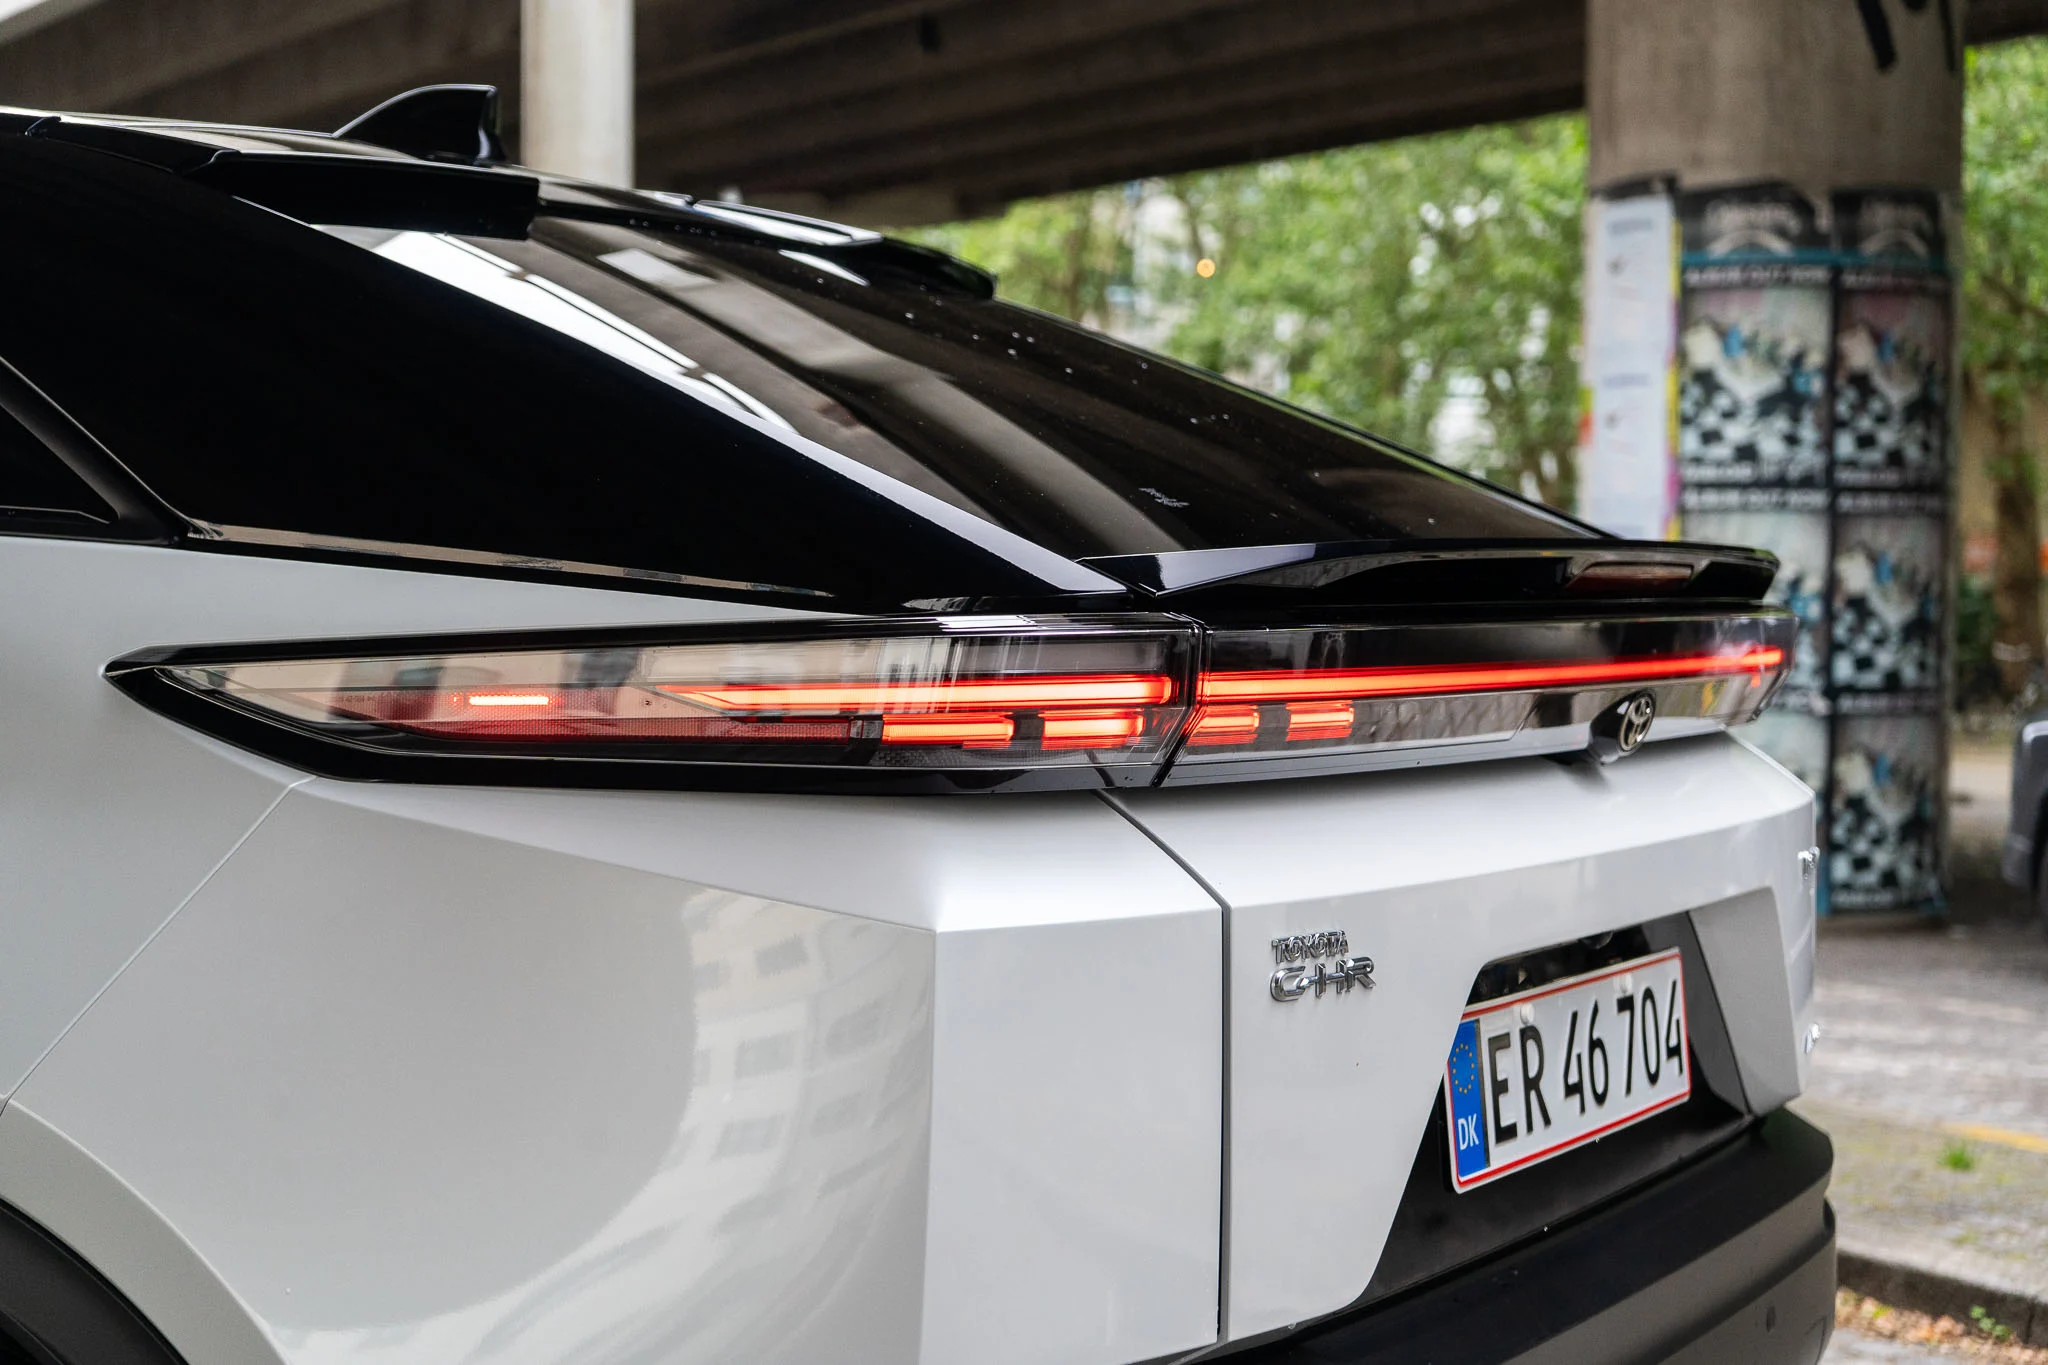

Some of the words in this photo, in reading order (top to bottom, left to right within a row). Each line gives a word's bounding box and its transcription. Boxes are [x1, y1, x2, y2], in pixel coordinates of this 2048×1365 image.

[1271, 930, 1349, 964] TOYOTA
[1270, 957, 1376, 1002] C-HR
[1487, 1025, 1552, 1145] ER
[1562, 999, 1609, 1117] 46
[1615, 978, 1684, 1098] 704
[1457, 1113, 1480, 1151] DK
